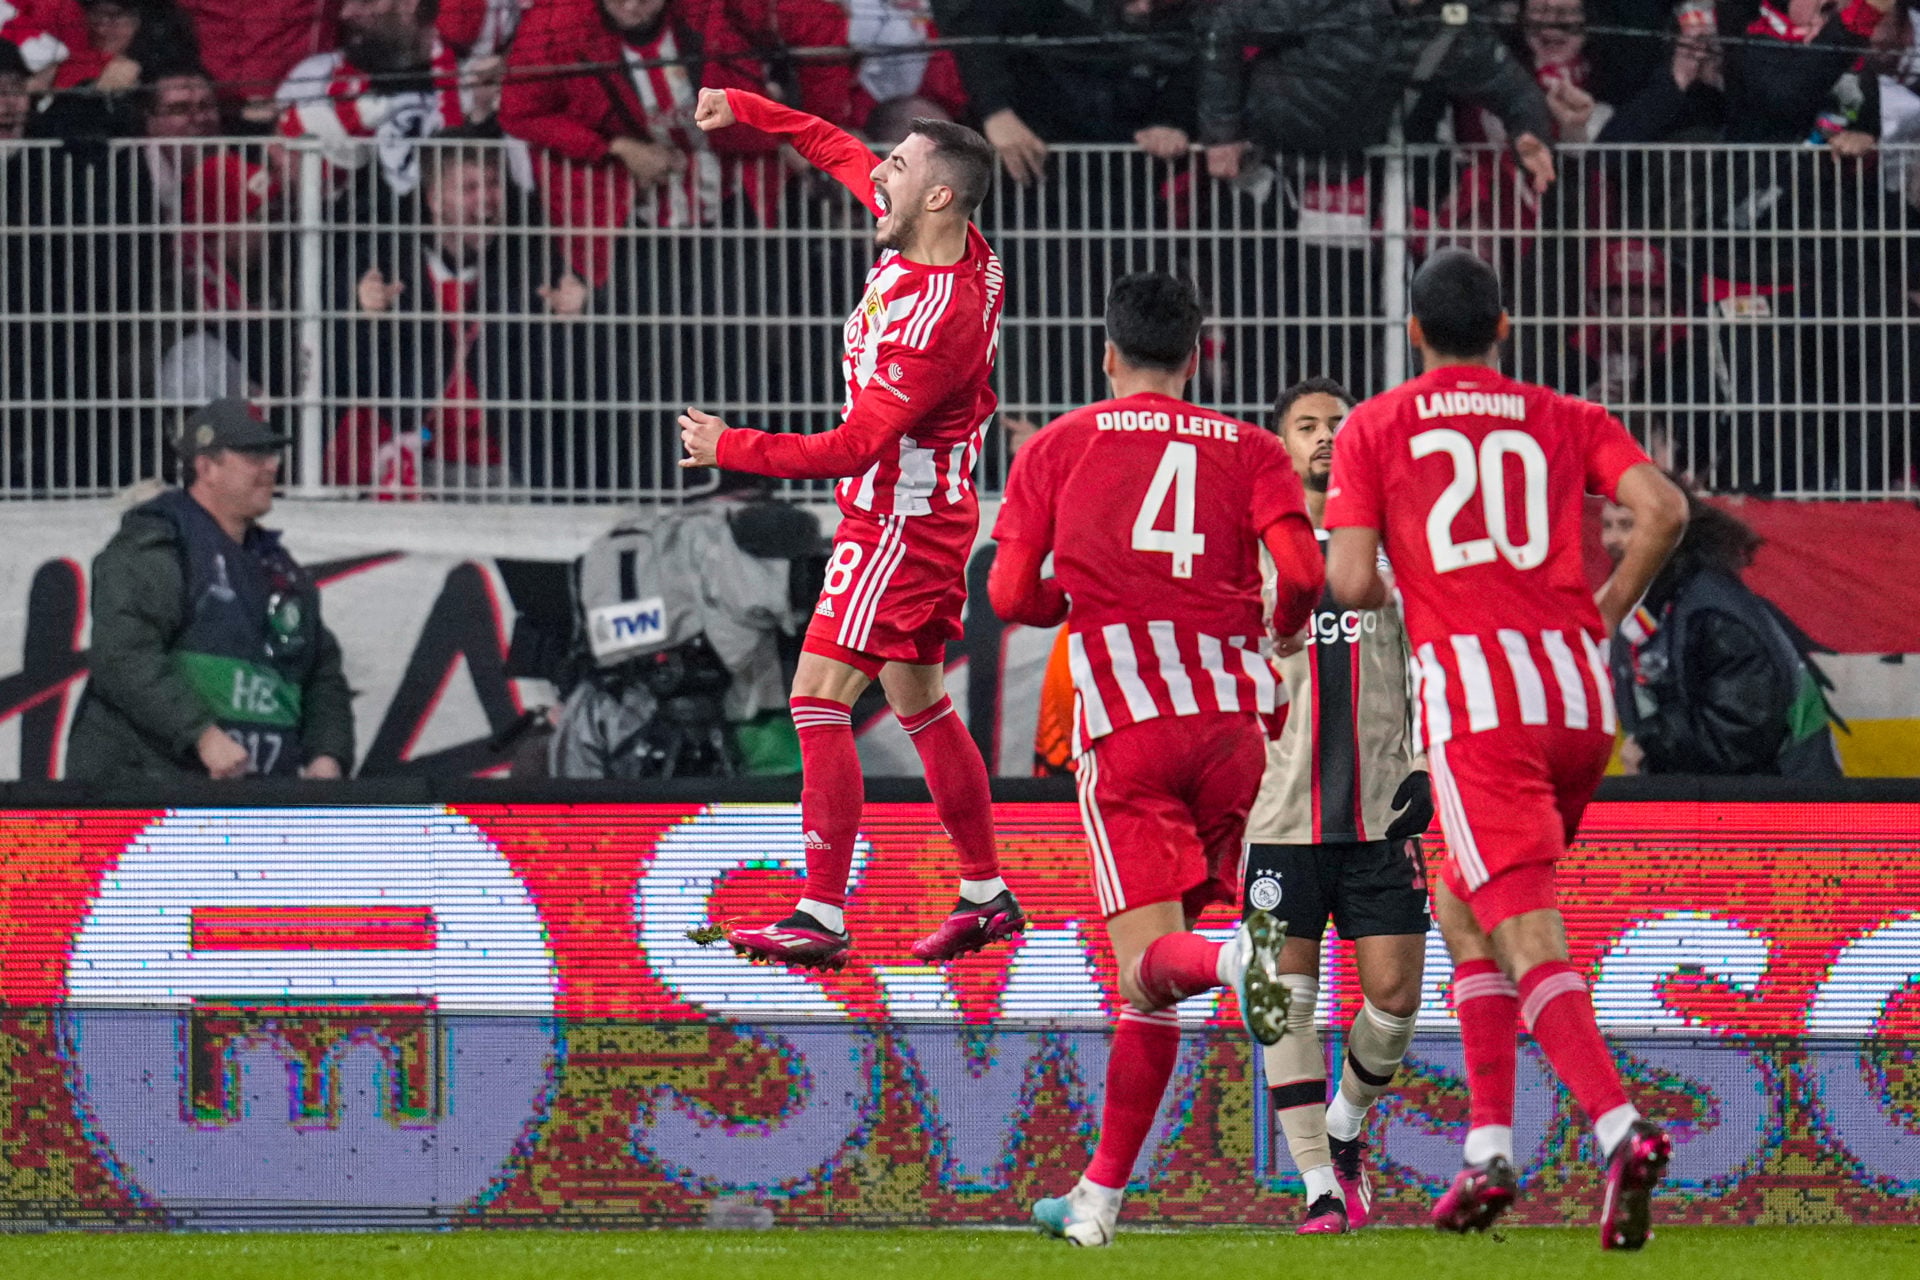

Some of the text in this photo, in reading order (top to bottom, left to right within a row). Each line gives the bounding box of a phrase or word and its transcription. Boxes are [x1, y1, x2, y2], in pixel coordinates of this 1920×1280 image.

[1415, 391, 1526, 422] LAIDOUNI
[1095, 410, 1239, 443] DIOGO LEITE
[1131, 440, 1206, 579] 4
[1409, 428, 1550, 574] 20
[612, 609, 660, 639] TVN
[1303, 609, 1377, 645] iggo
